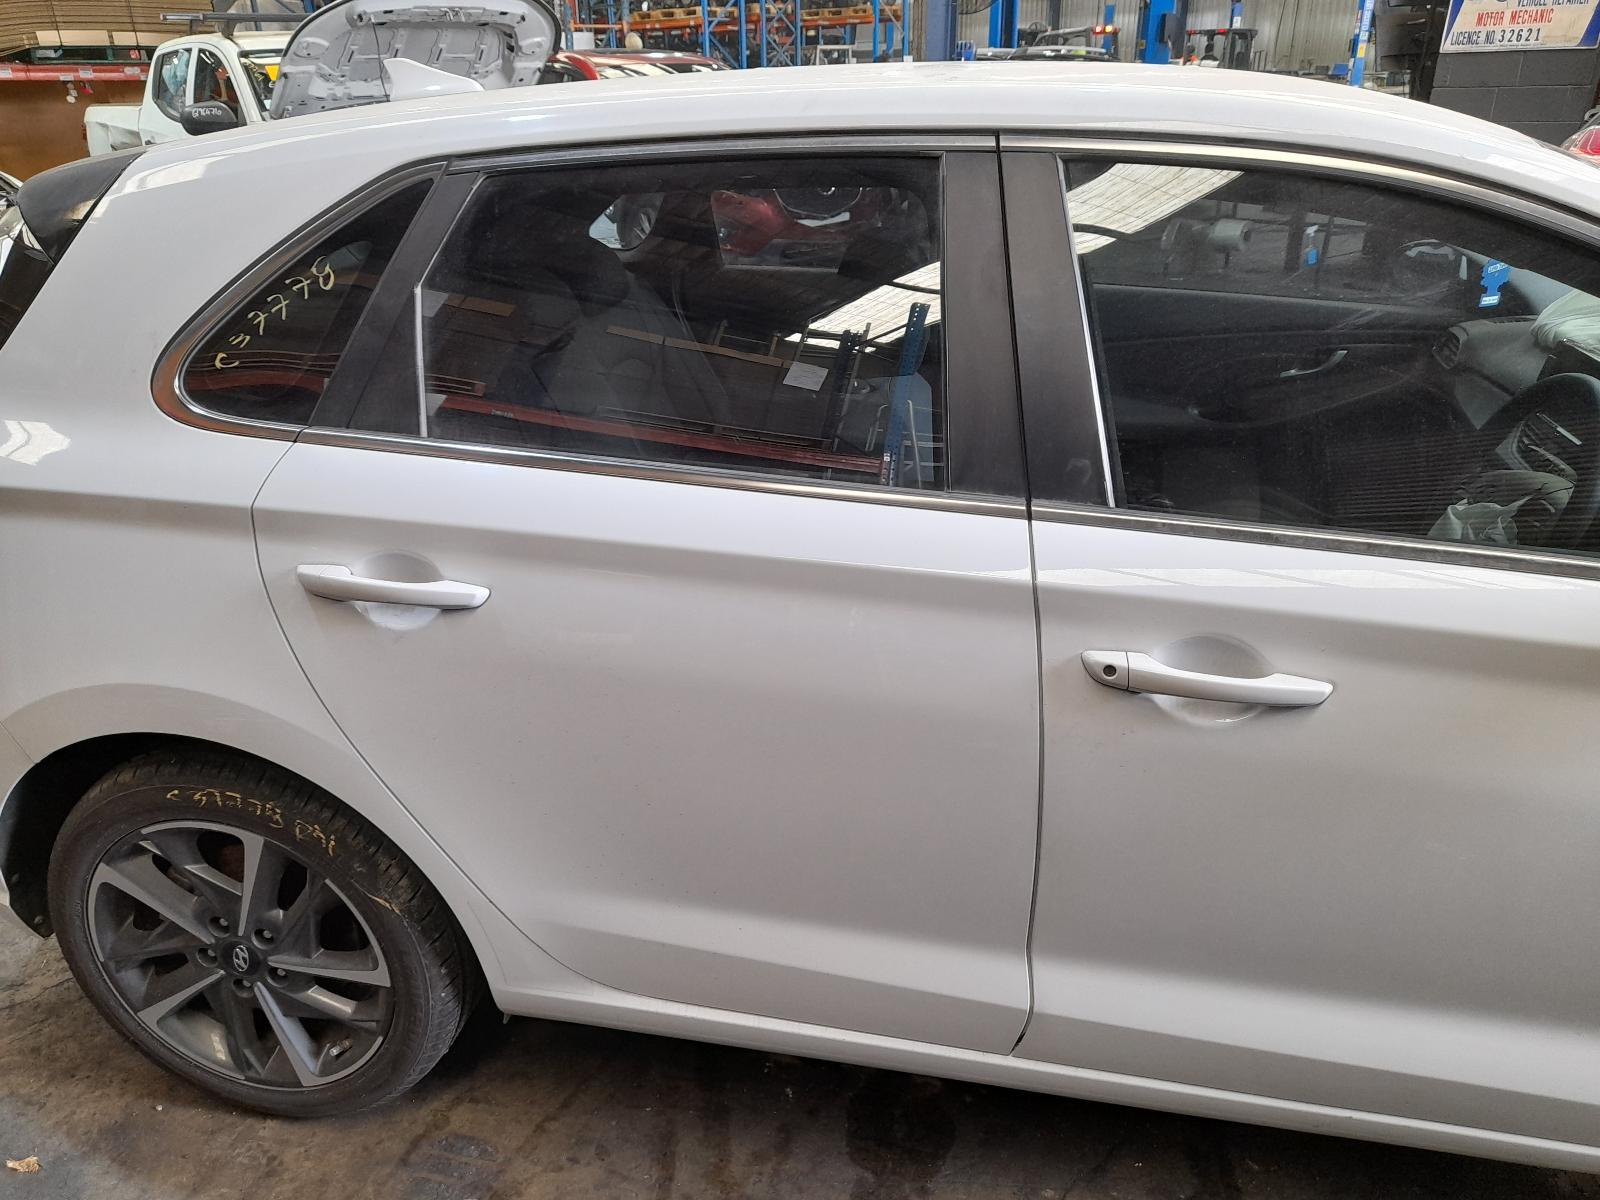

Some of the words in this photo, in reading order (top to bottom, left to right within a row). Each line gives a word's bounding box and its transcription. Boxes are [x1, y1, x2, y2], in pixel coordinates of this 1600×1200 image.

[1475, 11, 1504, 27] MOTOR
[1509, 8, 1554, 25] MECHANIC
[1450, 31, 1481, 46] LICENCE
[1498, 28, 1541, 43] 32621
